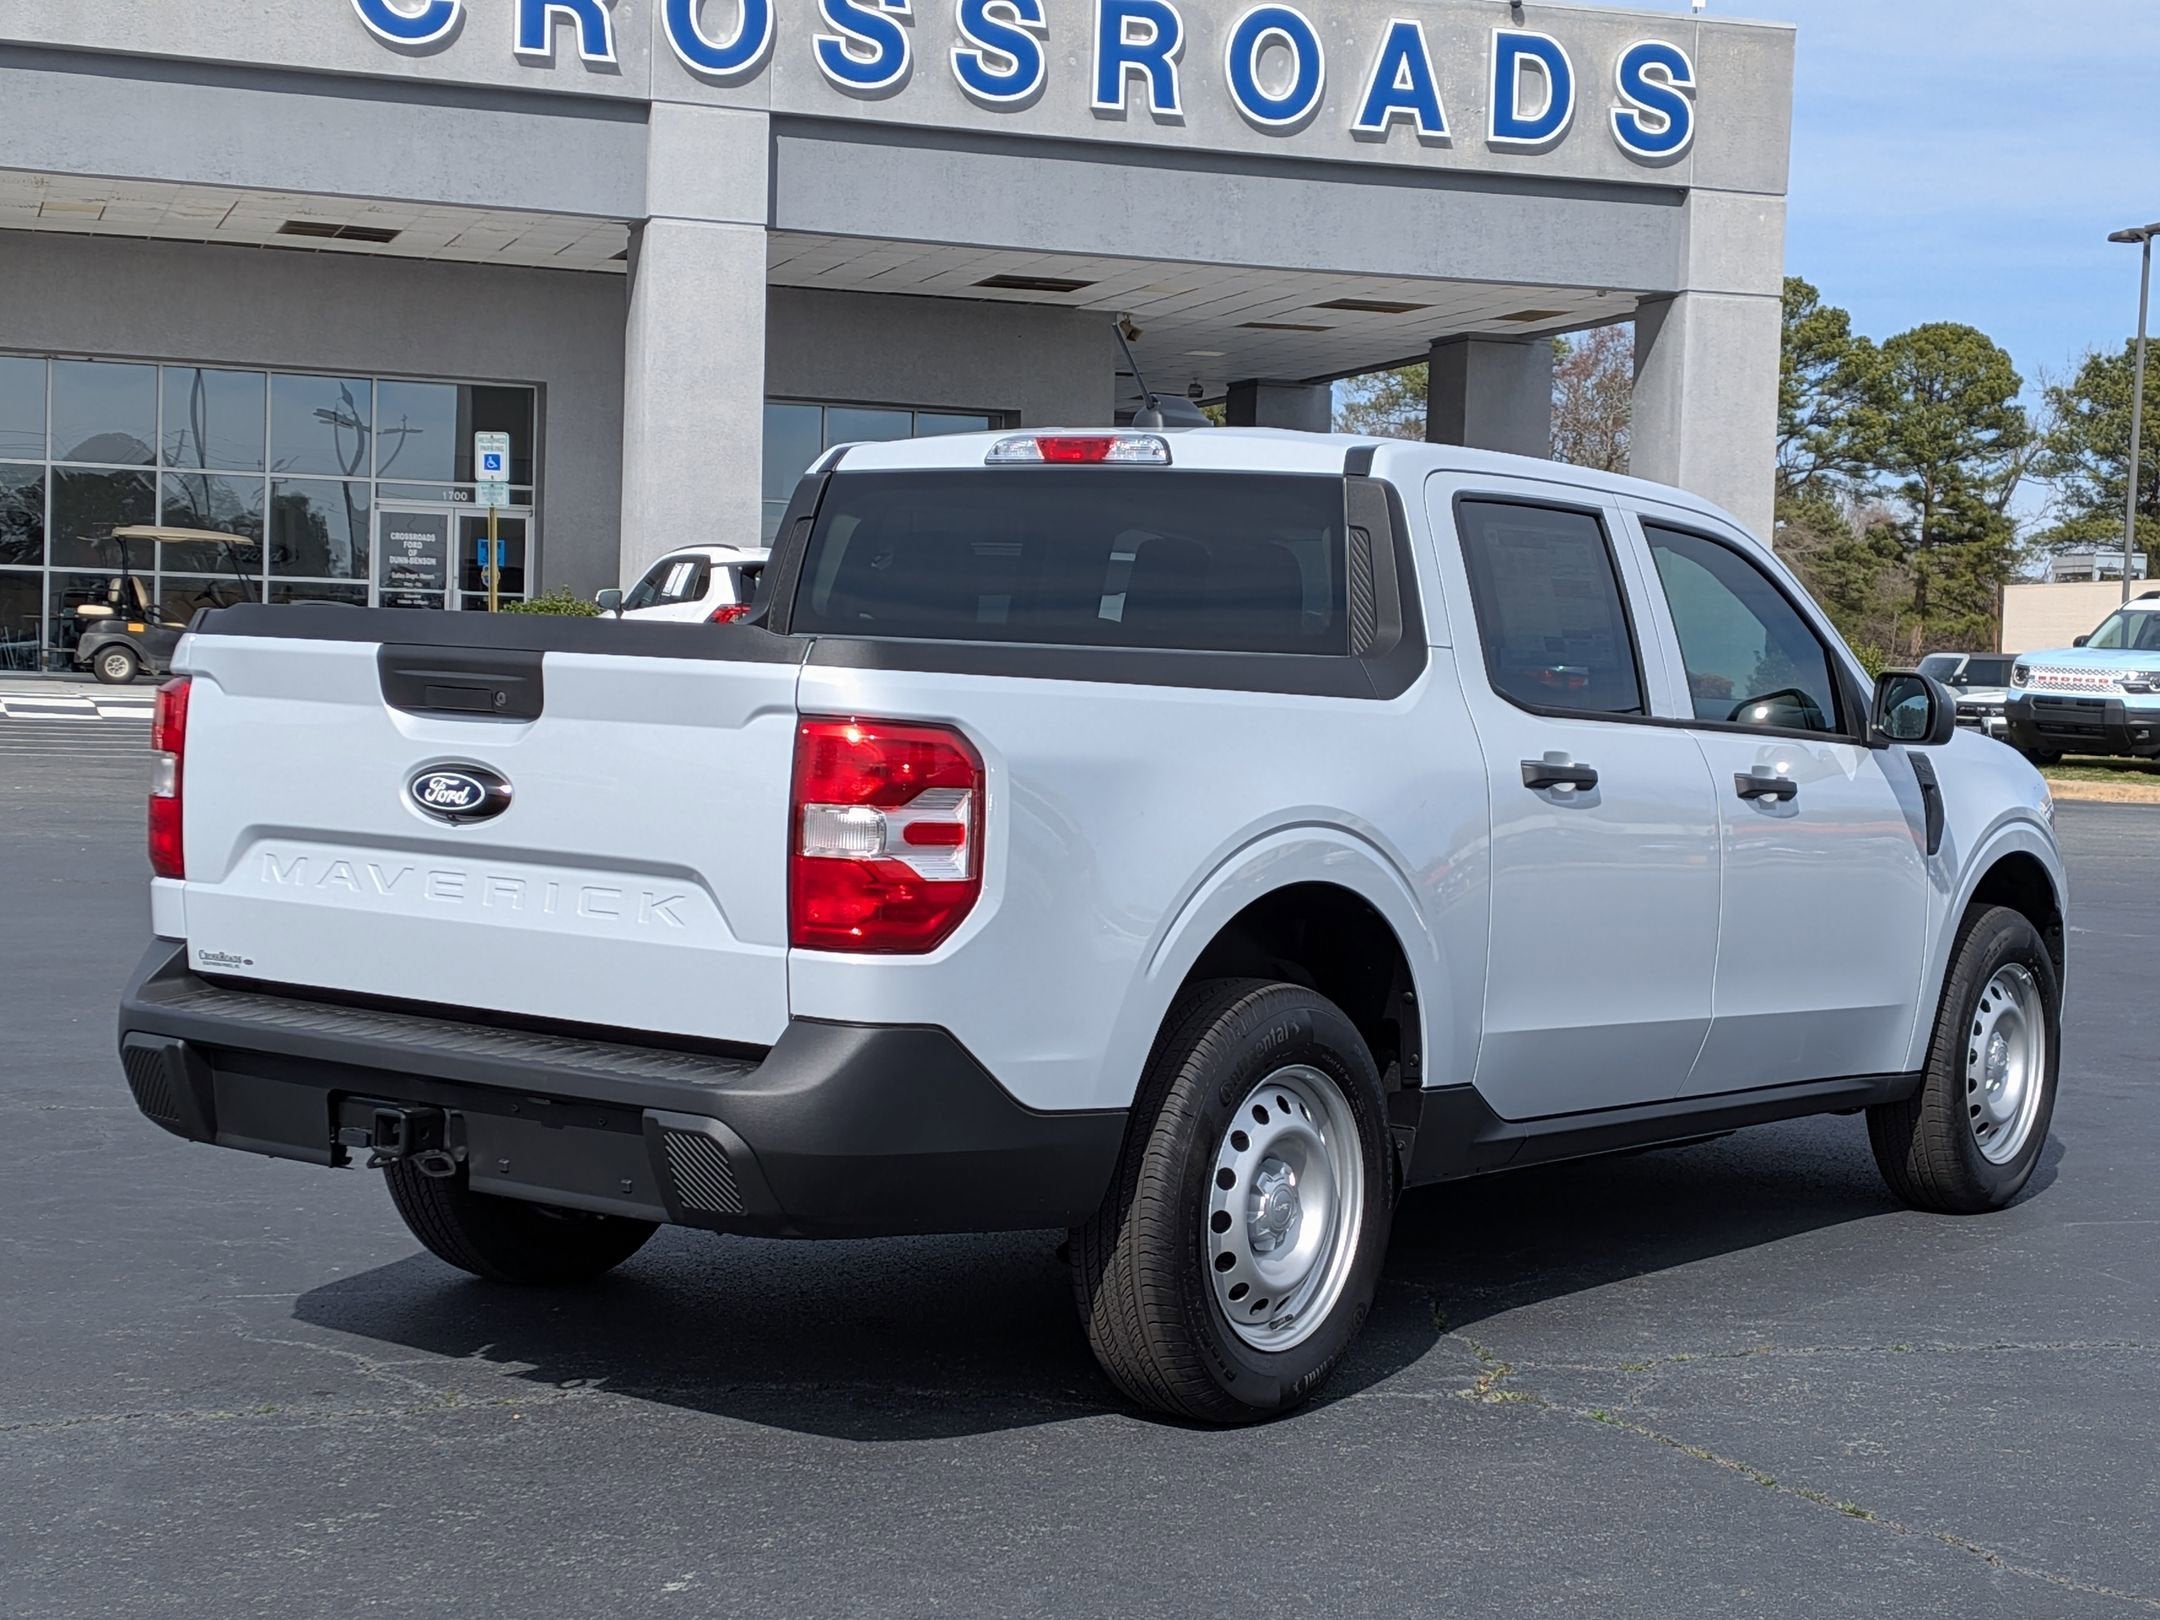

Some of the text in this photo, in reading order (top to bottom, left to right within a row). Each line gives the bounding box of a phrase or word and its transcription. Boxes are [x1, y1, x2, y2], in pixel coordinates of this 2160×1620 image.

[442, 490, 468, 501] 1700
[390, 532, 436, 542] CROSSROADS
[403, 541, 423, 549] FORD
[2038, 675, 2109, 684] BRONCO
[424, 776, 471, 805] Ford
[260, 852, 687, 927] MAVERICK
